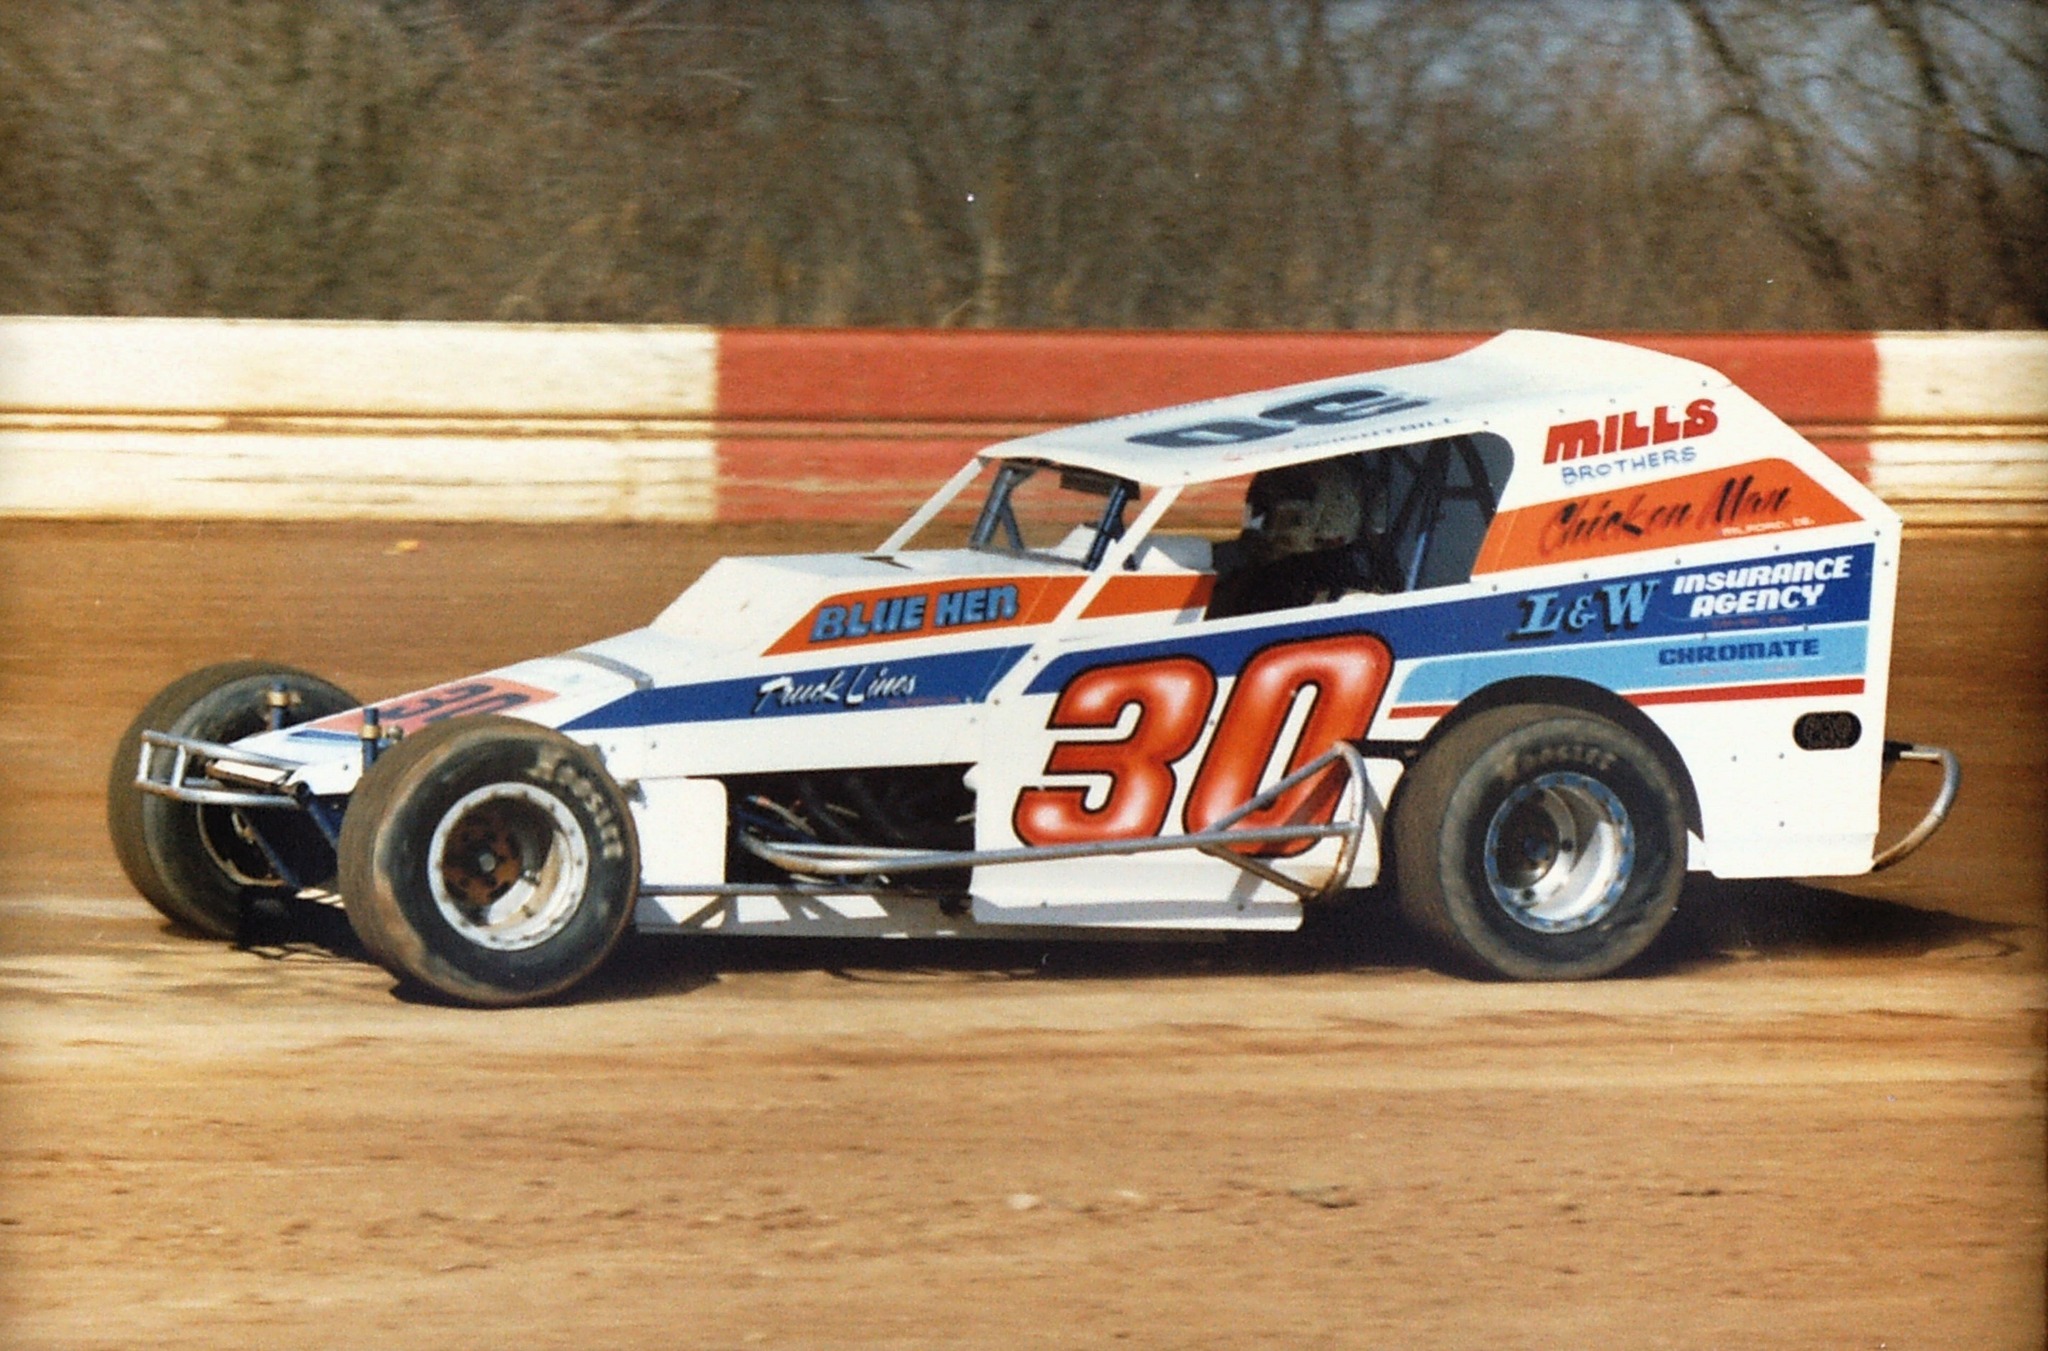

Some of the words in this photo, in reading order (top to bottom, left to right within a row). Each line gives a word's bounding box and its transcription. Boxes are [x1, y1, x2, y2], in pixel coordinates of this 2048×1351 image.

[1543, 398, 1719, 464] MILLS
[1562, 446, 1698, 486] BROTHERS
[1540, 494, 1692, 557] Chicken
[1695, 474, 1792, 530] Man
[1672, 554, 1853, 595] INSURANCE
[809, 594, 928, 643] BLUE
[933, 583, 1020, 629] HEN
[1690, 583, 1826, 618] AGENCY
[1658, 638, 1820, 666] CHROMATE
[751, 670, 846, 714] Truck
[844, 666, 917, 708] Lines
[1011, 629, 1394, 858] 30
